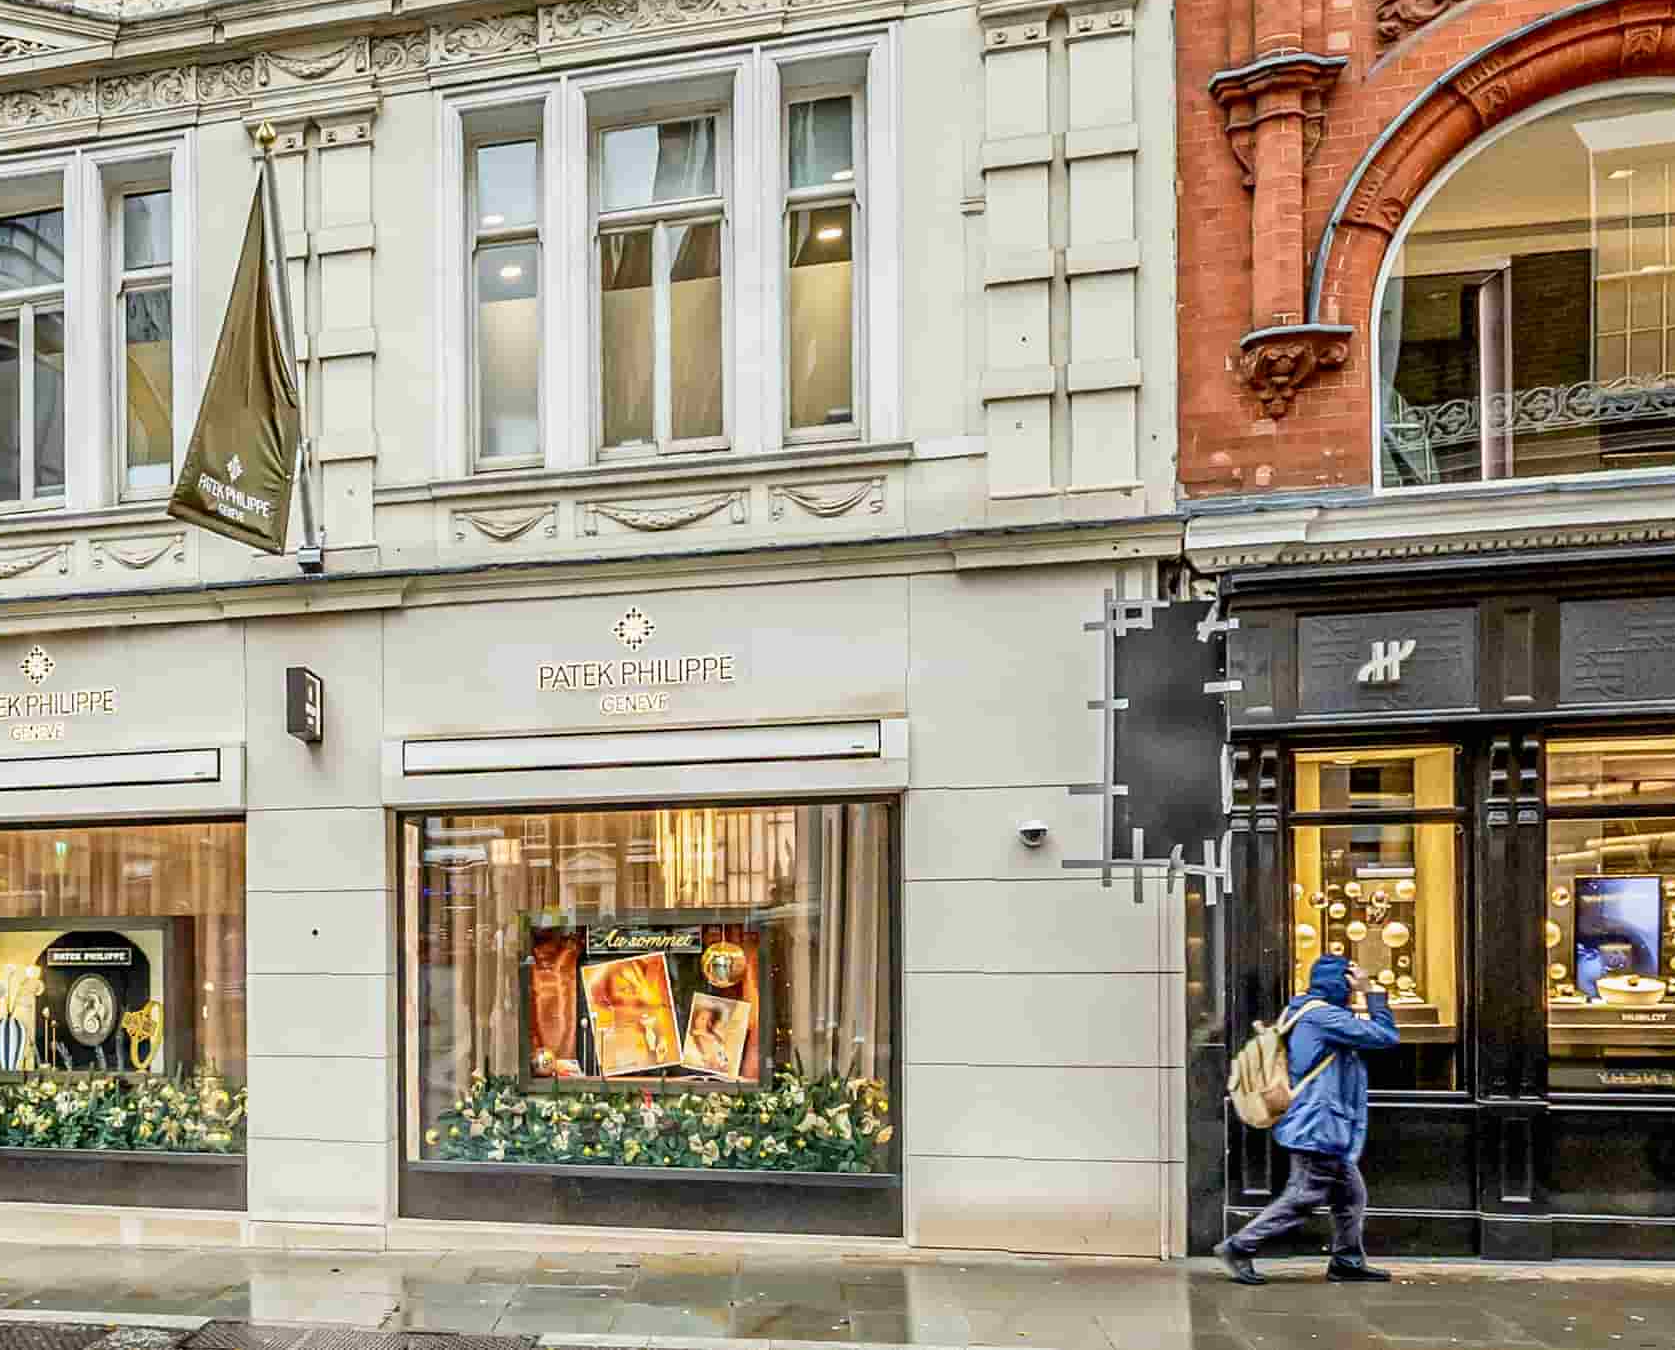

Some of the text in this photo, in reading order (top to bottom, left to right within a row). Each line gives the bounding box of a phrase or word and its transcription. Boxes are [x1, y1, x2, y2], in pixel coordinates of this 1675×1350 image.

[225, 485, 272, 517] PHILIPPE
[539, 654, 735, 691] PATEK PHILIPPE
[24, 688, 116, 717] PHILIPPE
